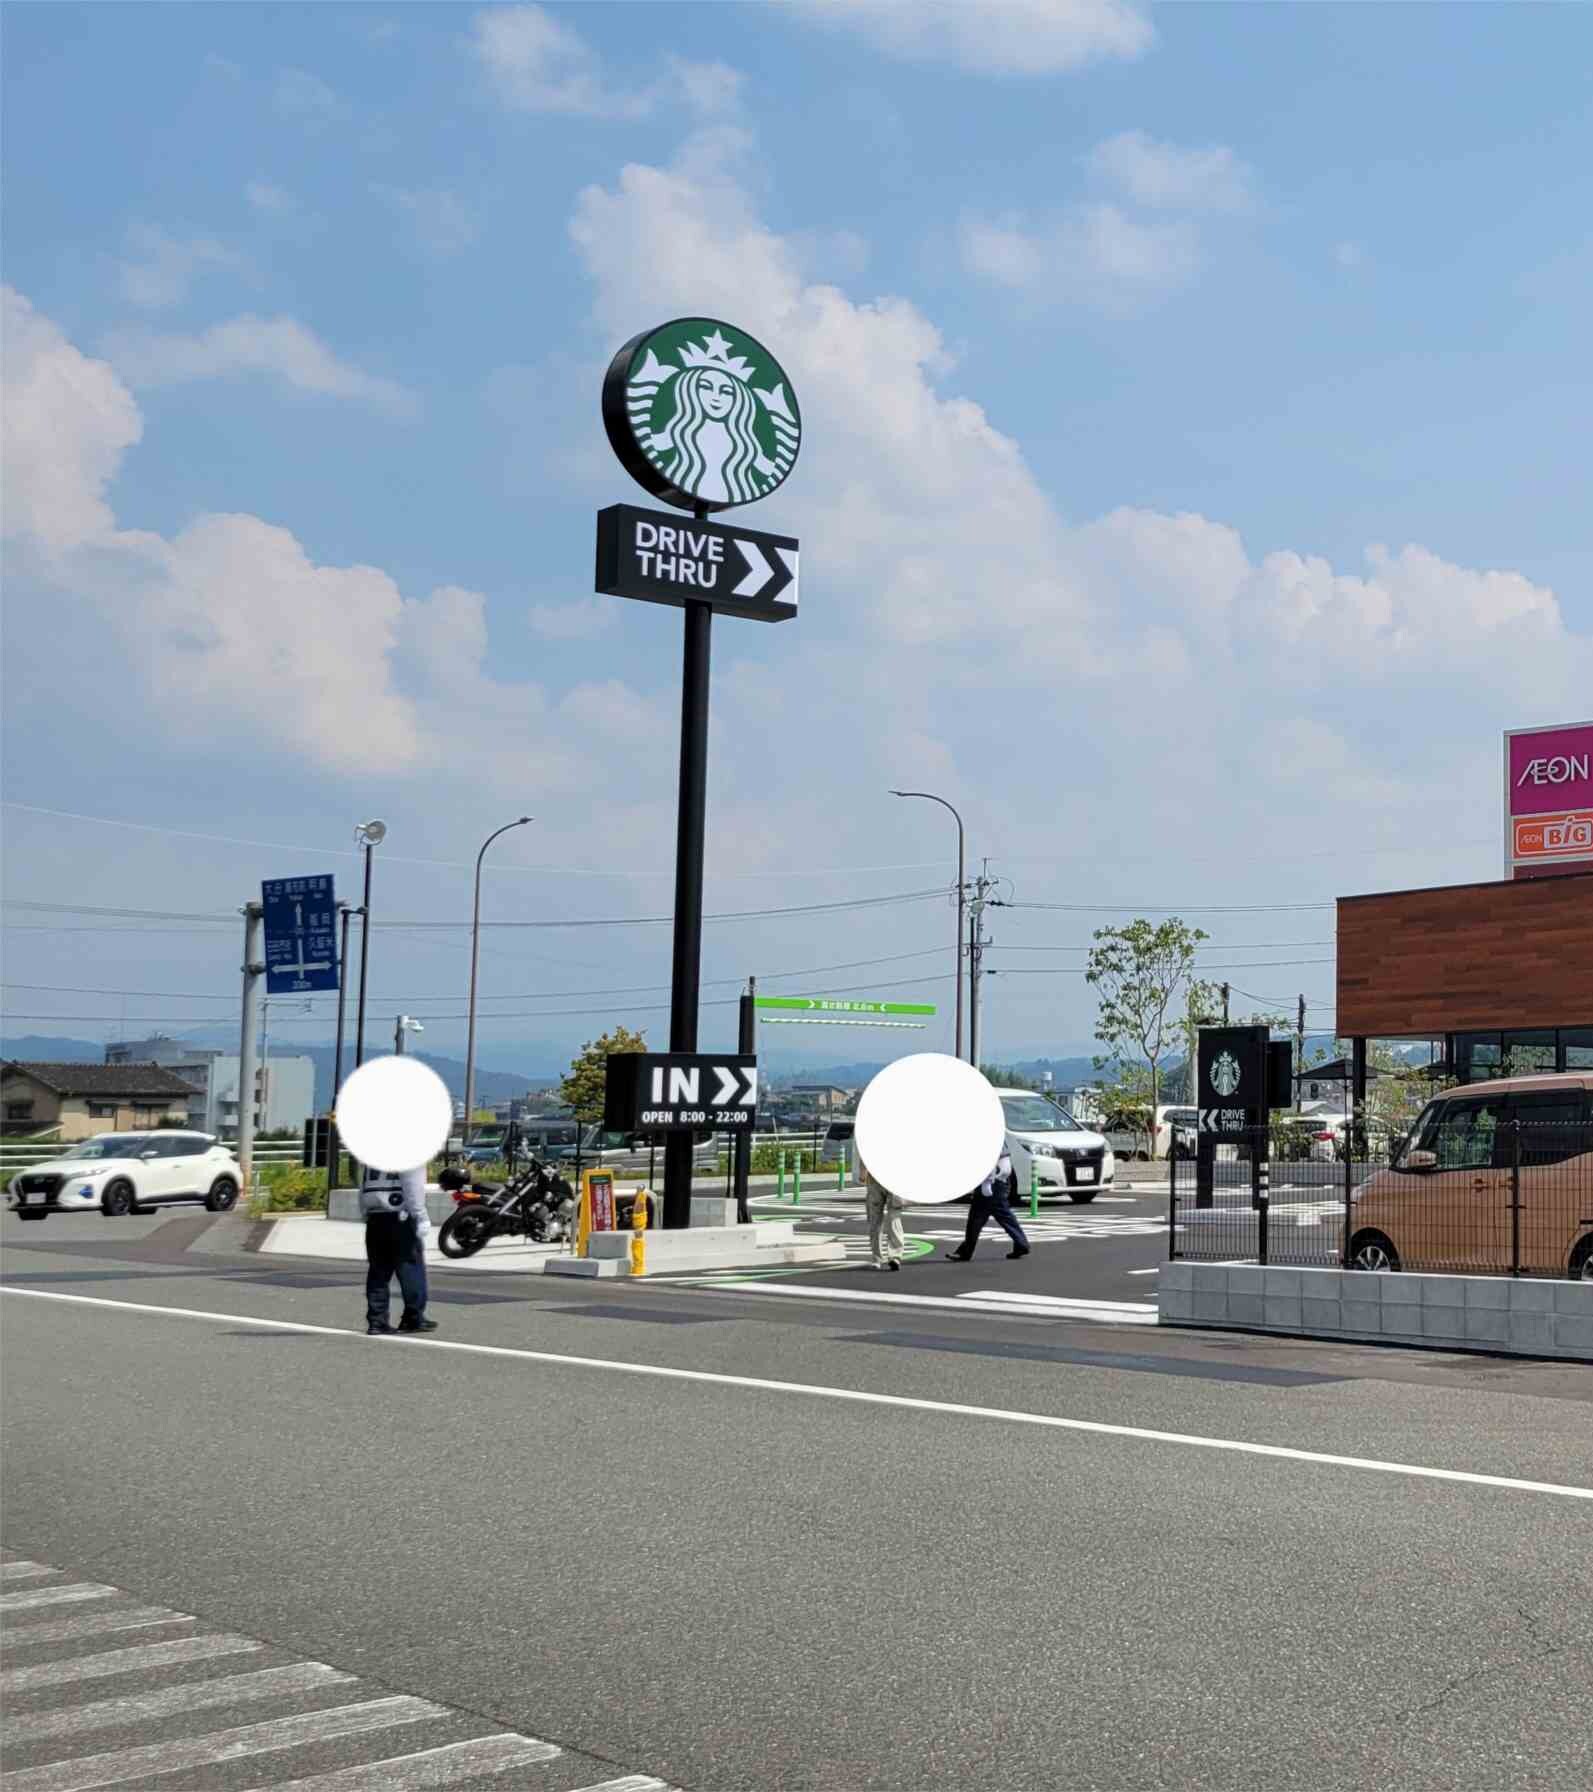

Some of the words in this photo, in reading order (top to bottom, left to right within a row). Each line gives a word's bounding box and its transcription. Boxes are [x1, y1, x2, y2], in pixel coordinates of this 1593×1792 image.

[635, 521, 725, 562] DRIVE
[636, 550, 718, 588] THRU
[652, 1066, 700, 1104] IN
[641, 1111, 673, 1123] OPEN
[679, 1111, 706, 1123] 8:00
[716, 1111, 748, 1123] 22:00
[1220, 1109, 1246, 1121] DRIVE
[1220, 1120, 1244, 1131] THRU
